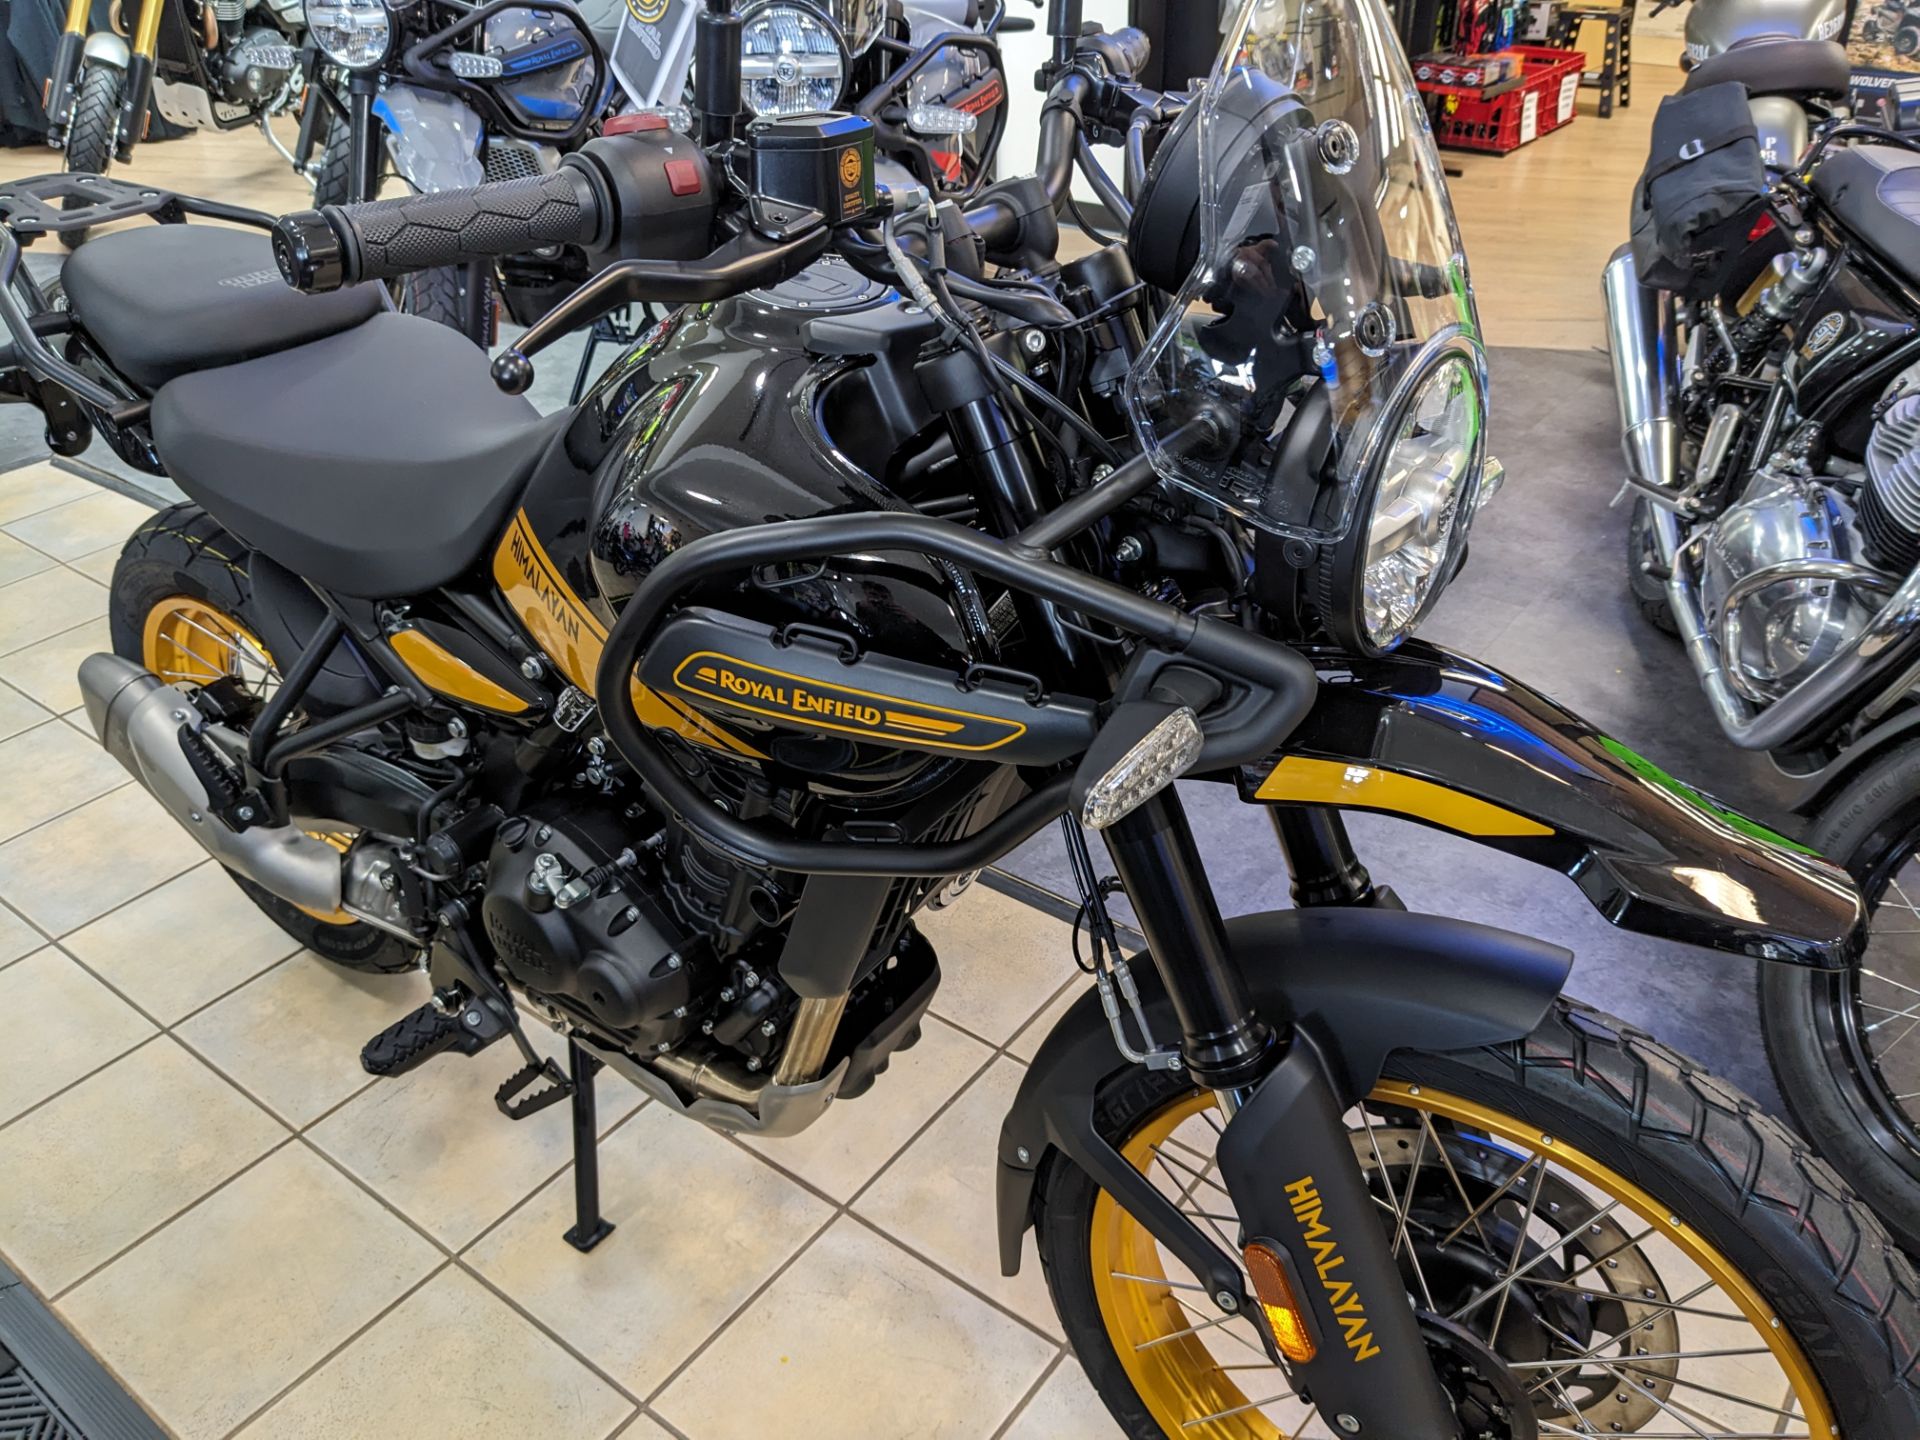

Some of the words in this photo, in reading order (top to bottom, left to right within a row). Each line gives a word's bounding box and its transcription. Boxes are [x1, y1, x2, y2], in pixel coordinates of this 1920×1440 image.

[511, 530, 579, 644] HIMALAYAN
[720, 669, 788, 705] ROYAL
[792, 688, 882, 726] ENFIELD
[1284, 1175, 1381, 1362] HIMALAYAN
